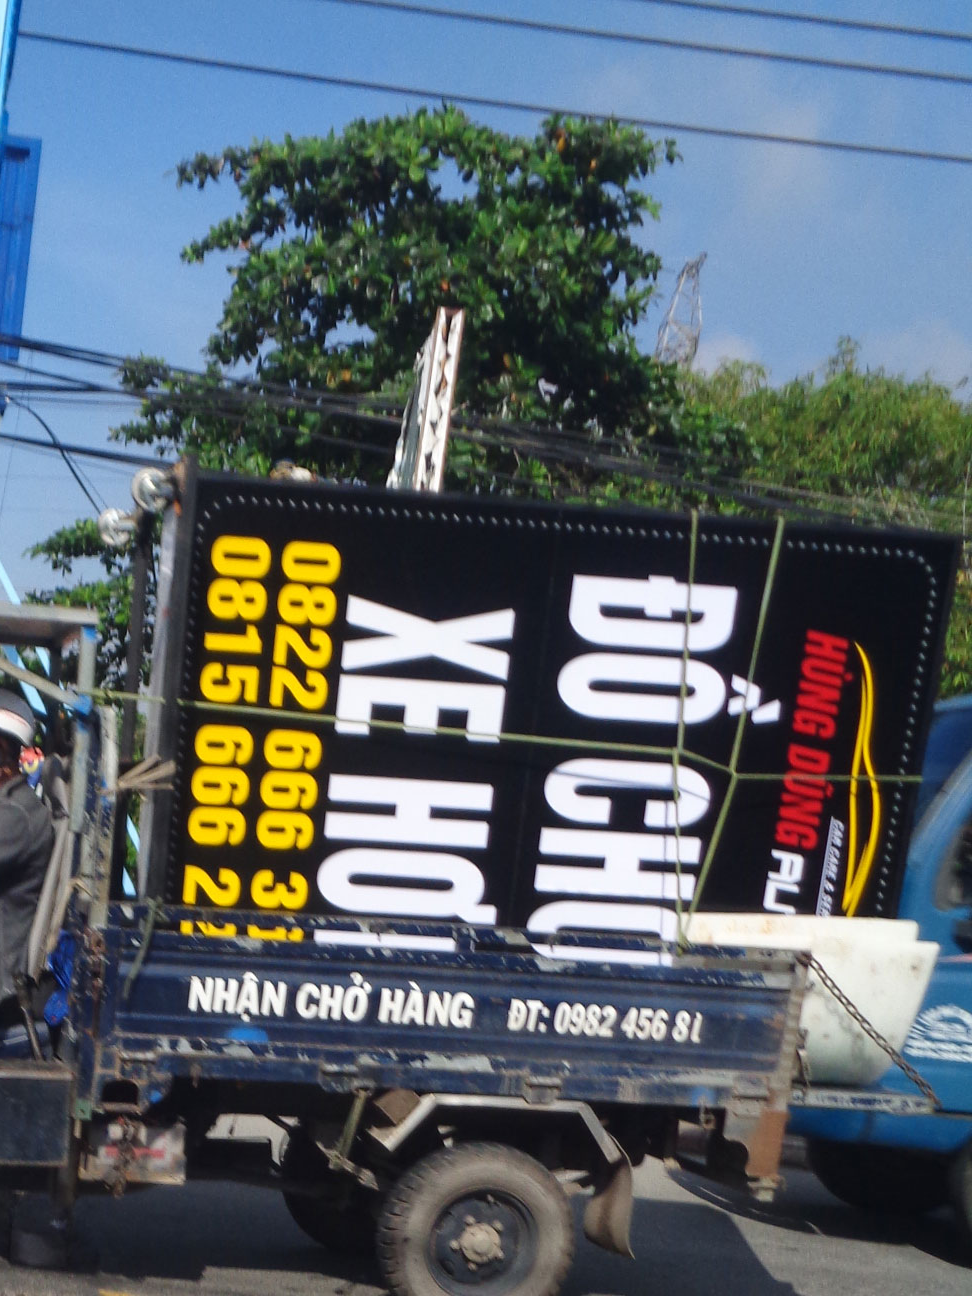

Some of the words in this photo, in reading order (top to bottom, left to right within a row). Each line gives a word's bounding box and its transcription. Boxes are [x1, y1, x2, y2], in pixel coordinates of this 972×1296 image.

[199, 534, 271, 704] 0815
[268, 540, 343, 711] 0822
[334, 595, 515, 743] XE
[558, 574, 781, 726] ĐỒ
[187, 725, 254, 847] 666
[254, 728, 323, 851] 666
[762, 848, 806, 914] AU
[187, 971, 288, 1022] NHẬN
[295, 971, 372, 1023] CHỞ
[377, 980, 475, 1029] HÀNG
[507, 998, 550, 1033] ĐT:
[553, 1001, 617, 1037] 0982
[620, 1006, 669, 1042] 456
